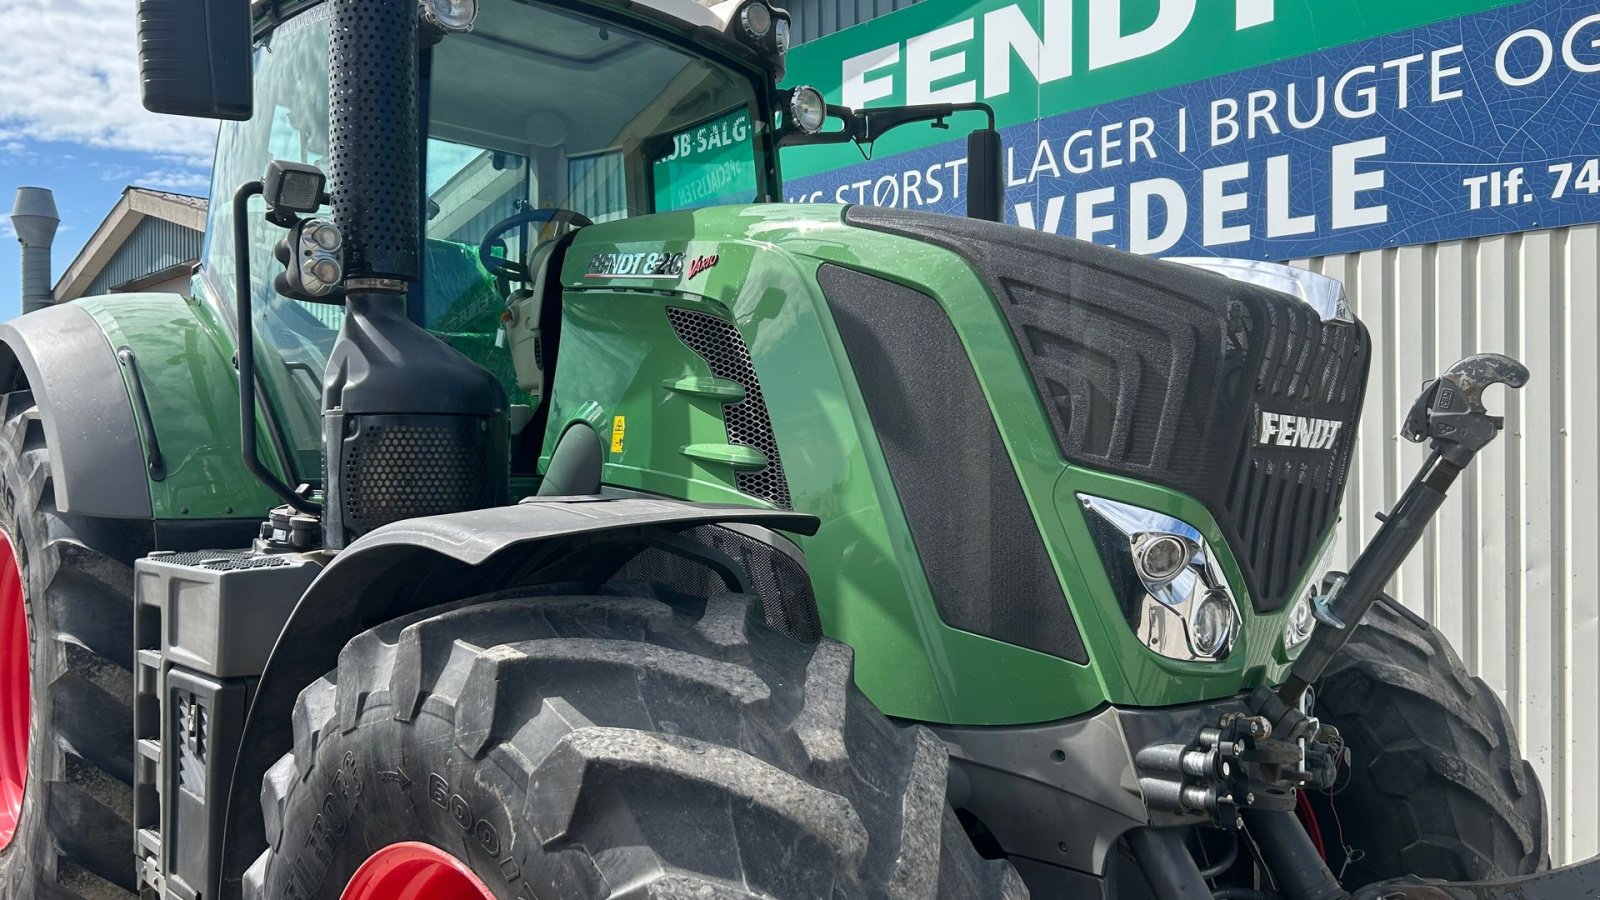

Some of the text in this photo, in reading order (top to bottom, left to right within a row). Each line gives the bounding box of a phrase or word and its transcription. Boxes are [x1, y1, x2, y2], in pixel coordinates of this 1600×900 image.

[842, 0, 1274, 111] FEND
[836, 13, 1600, 208] STØRST LAGER I BRUGTE OG
[1462, 166, 1533, 209] Tlf.
[589, 252, 646, 275] FENDT
[1260, 411, 1342, 449] FENDT
